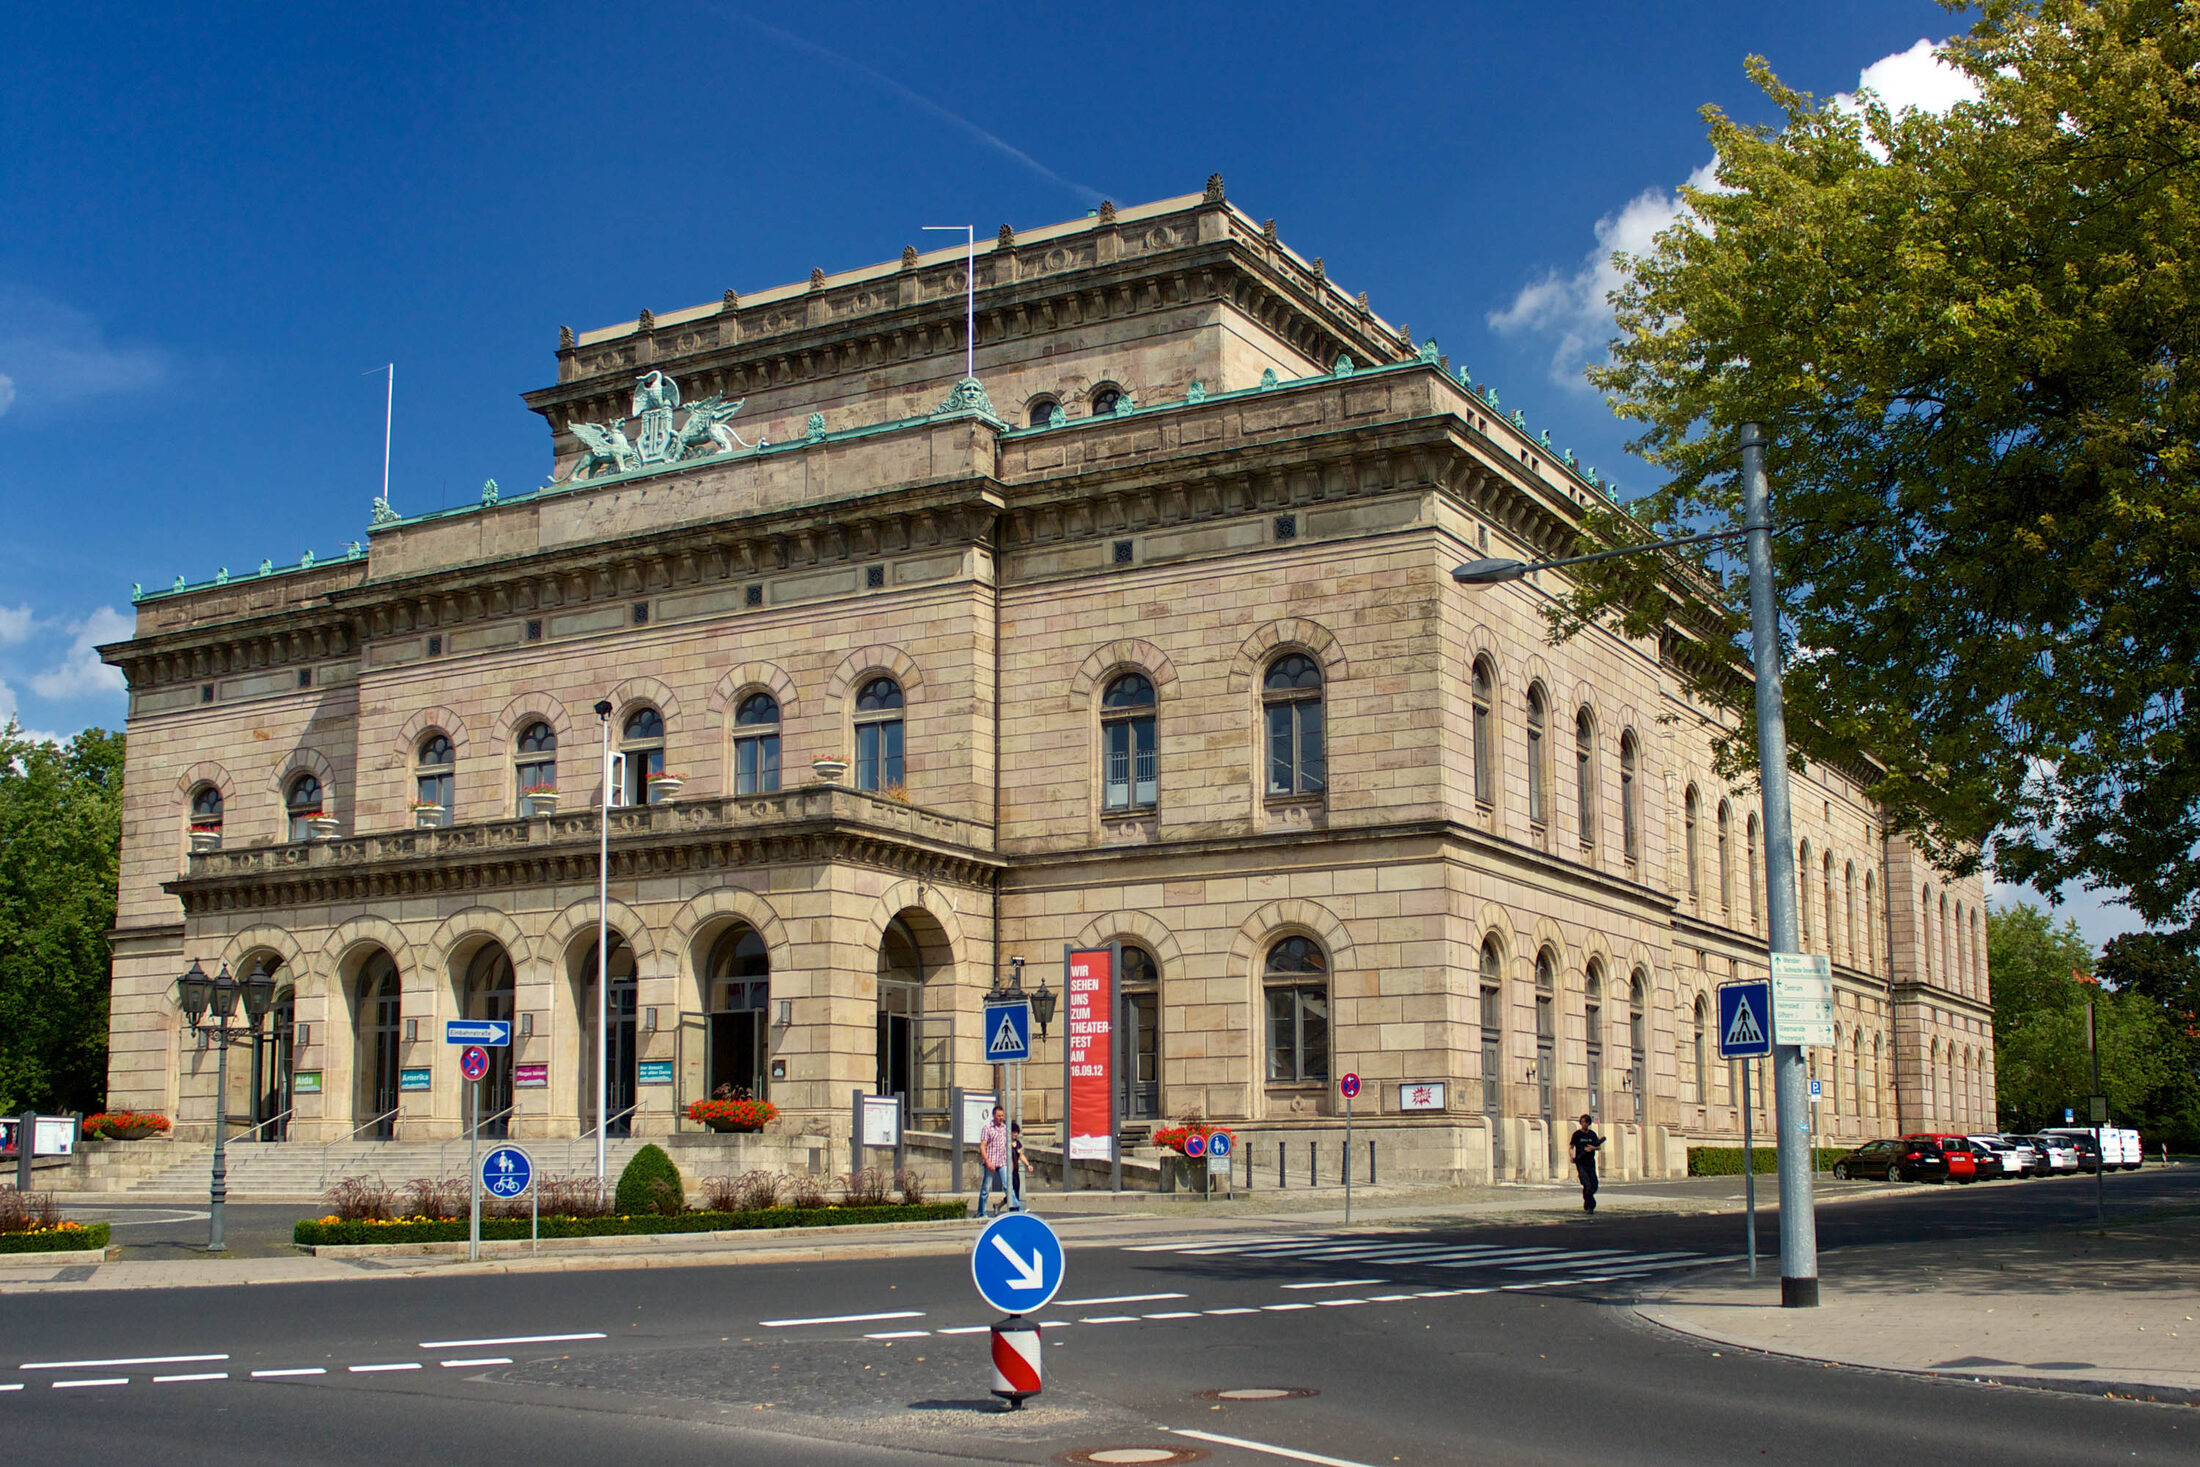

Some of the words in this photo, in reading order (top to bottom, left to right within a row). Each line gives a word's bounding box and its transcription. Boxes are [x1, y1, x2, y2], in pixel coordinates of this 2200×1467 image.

[1071, 965, 1089, 977] WIR
[1071, 978, 1099, 991] SEHEN
[1071, 993, 1089, 1006] UNS
[1071, 1007, 1091, 1020] ZUM
[1071, 1021, 1112, 1034] THEATER-
[1071, 1036, 1092, 1048] FEST
[1071, 1050, 1085, 1062] AM
[1071, 1064, 1104, 1076] 16.09.12
[296, 1075, 314, 1085] Aida
[402, 1073, 429, 1081] Amerika
